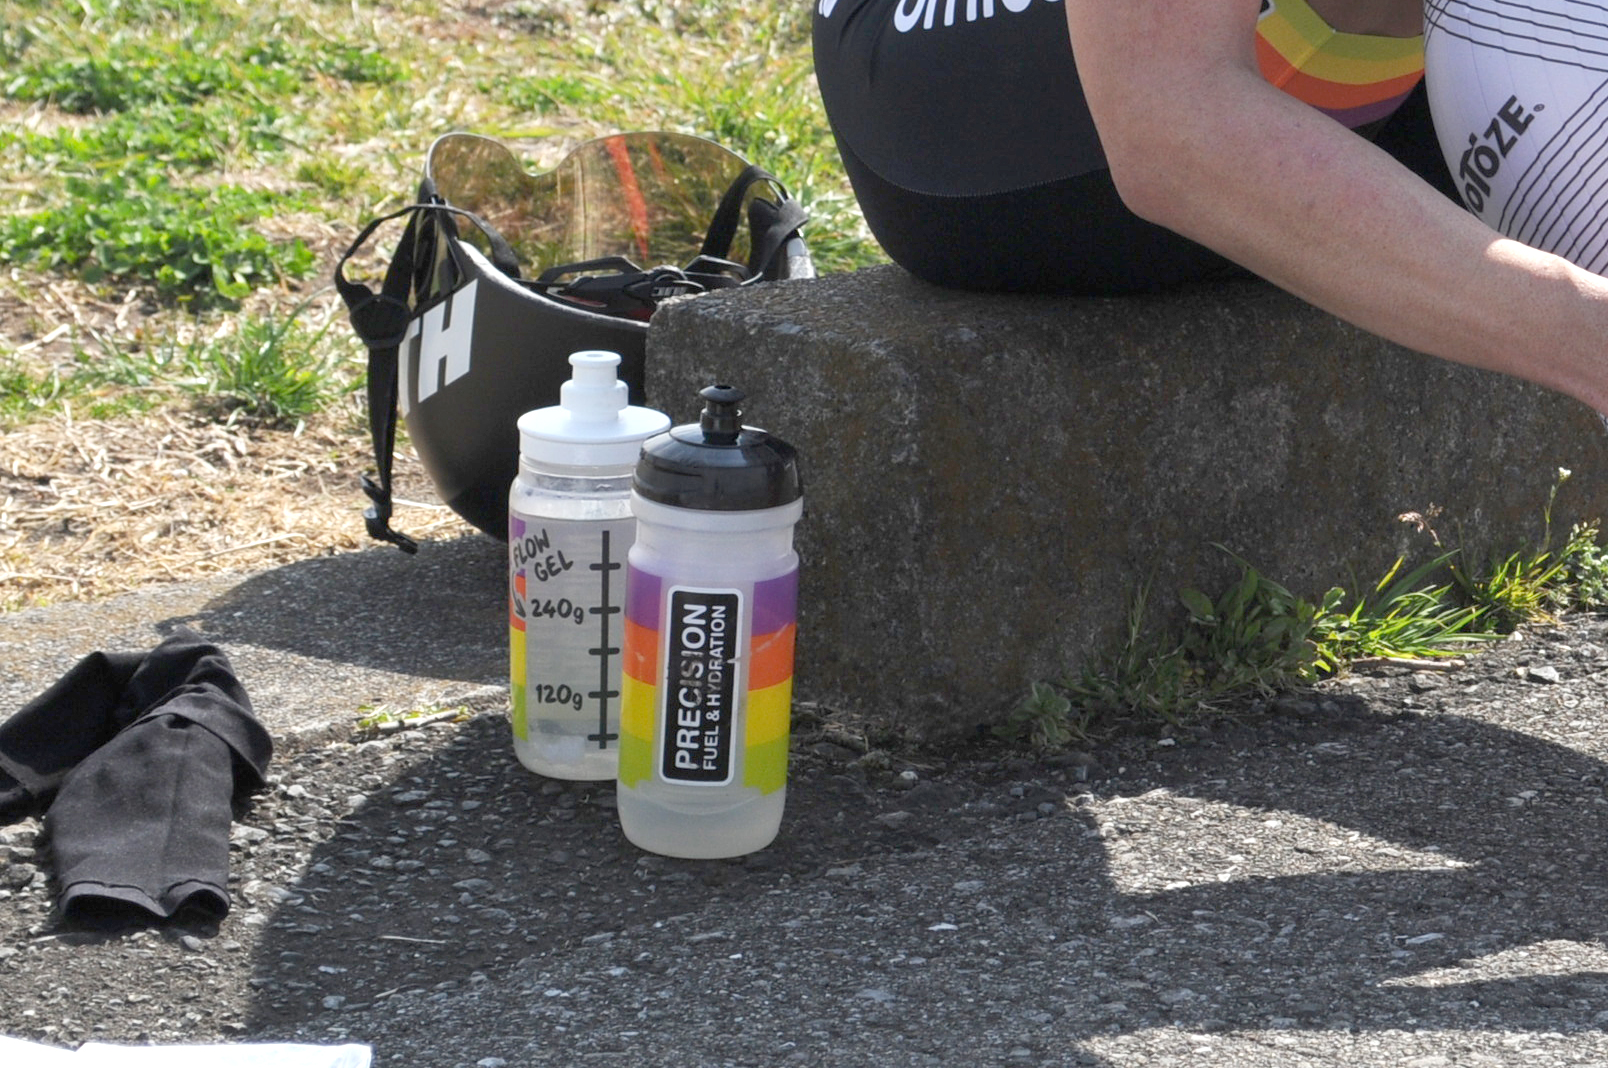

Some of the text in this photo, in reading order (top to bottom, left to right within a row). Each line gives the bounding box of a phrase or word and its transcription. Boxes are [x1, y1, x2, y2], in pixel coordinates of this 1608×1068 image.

[513, 528, 549, 568] FLOW
[534, 550, 574, 582] GEL
[531, 598, 584, 625] 240g
[536, 684, 582, 711] 120g
[675, 604, 707, 770] PRECISION
[703, 605, 726, 770] FUEL & HYDRATION
